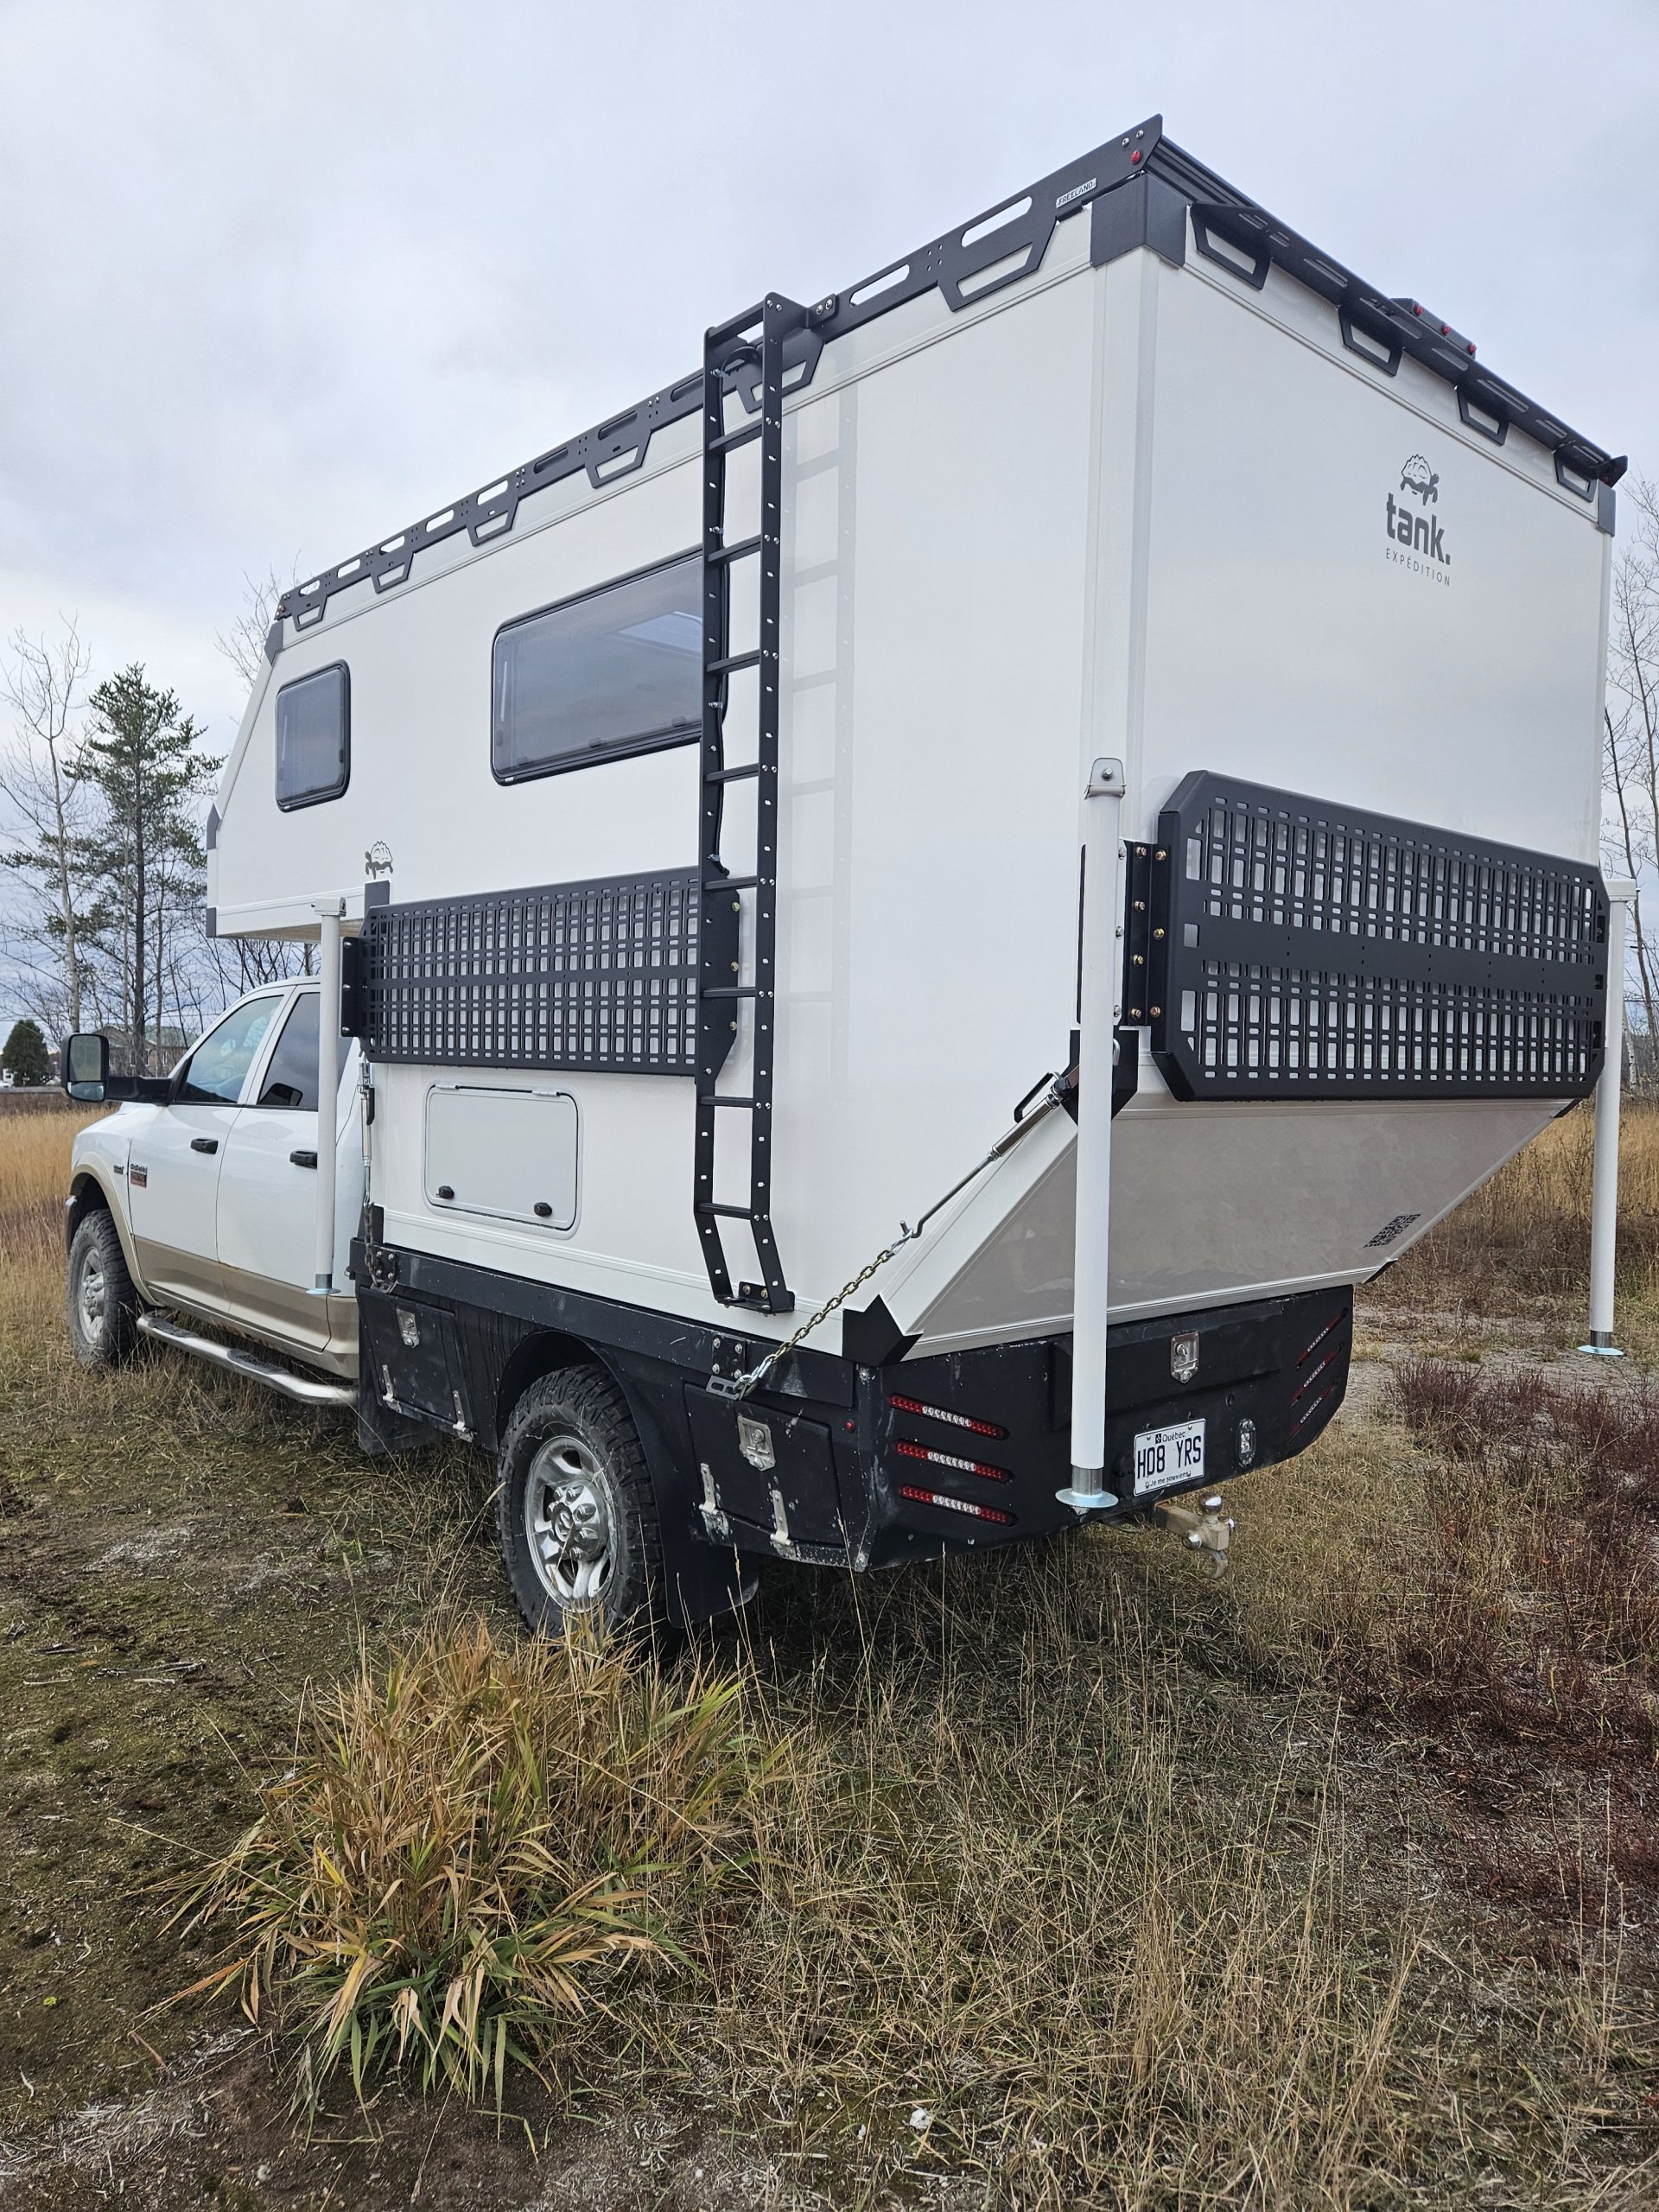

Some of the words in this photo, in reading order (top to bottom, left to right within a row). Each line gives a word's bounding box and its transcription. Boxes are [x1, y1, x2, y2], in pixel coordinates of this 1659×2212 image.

[1058, 181, 1093, 205] FREELAND
[1386, 493, 1451, 566] tank.
[1386, 548, 1450, 587] EXPÉDITION
[1162, 1431, 1185, 1442] Québec
[1137, 1445, 1165, 1479] H08
[1176, 1435, 1201, 1468] YRS
